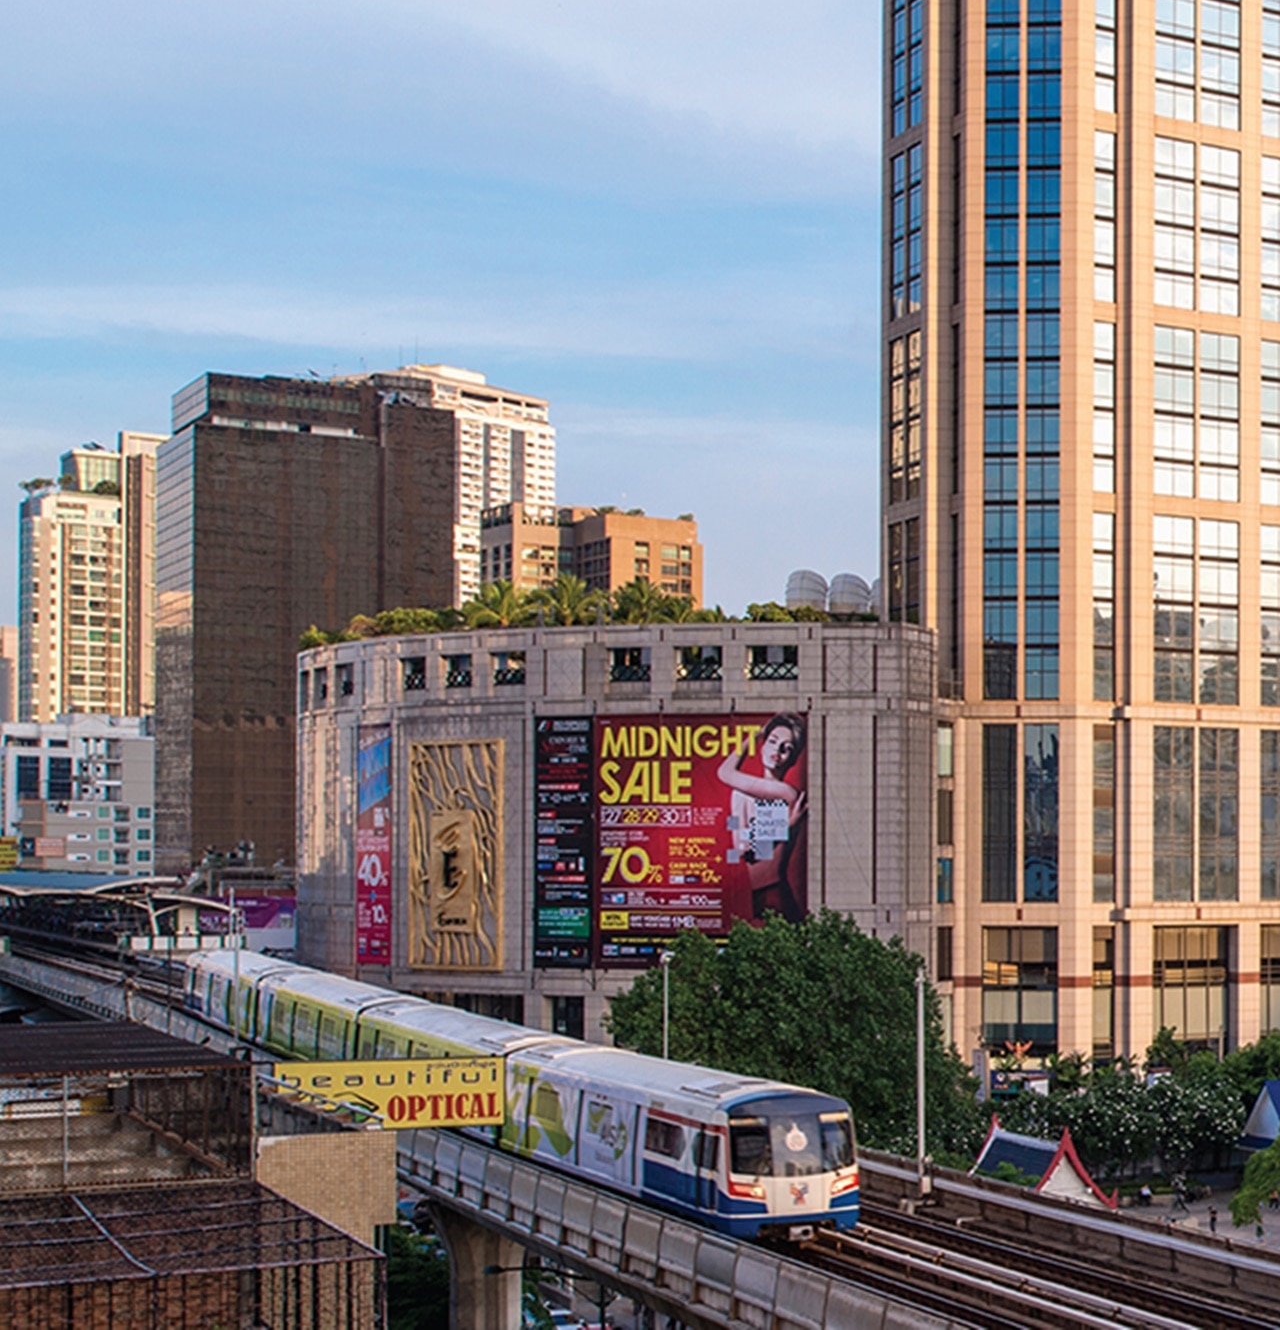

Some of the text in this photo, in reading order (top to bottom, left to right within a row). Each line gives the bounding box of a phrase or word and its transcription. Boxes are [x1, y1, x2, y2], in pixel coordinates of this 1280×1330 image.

[601, 725, 761, 759] MIDNIGHT
[599, 761, 692, 804] SALE
[623, 808, 641, 824] 28
[642, 808, 659, 824] 29
[660, 808, 680, 824] 30
[358, 853, 388, 887] 40%
[600, 846, 664, 884] 70%
[281, 1067, 497, 1089] beautiful
[387, 1092, 501, 1122] OPTICAL
